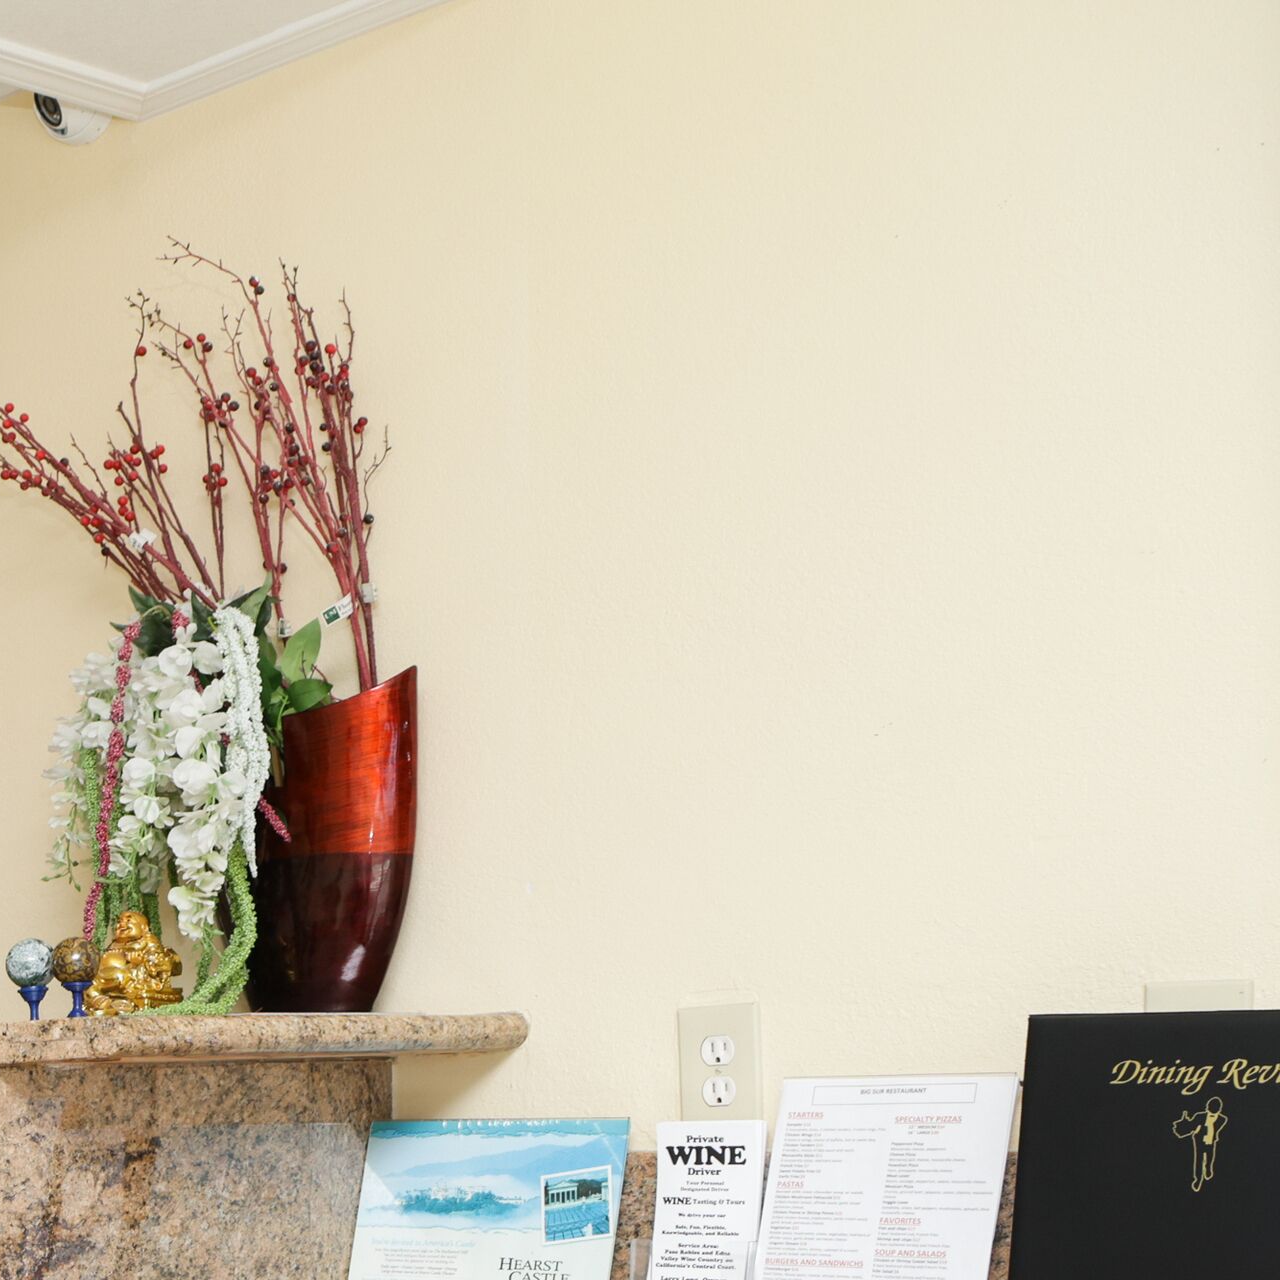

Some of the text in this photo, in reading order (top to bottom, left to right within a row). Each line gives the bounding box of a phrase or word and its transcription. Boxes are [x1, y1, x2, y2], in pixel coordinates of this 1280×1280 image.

[1109, 1058, 1214, 1095] Dining
[895, 1116, 934, 1124] SPECIALTY
[686, 1135, 724, 1143] Private
[666, 1145, 746, 1165] WINE
[687, 1167, 722, 1175] Driver
[777, 1181, 804, 1189] PASTAS
[662, 1197, 692, 1205] WINE
[879, 1217, 921, 1225] FAVORITES
[897, 1249, 915, 1257] AND
[917, 1250, 946, 1258] SALADS
[499, 1257, 564, 1271] HEARST
[819, 1259, 864, 1267] SANDWICHS
